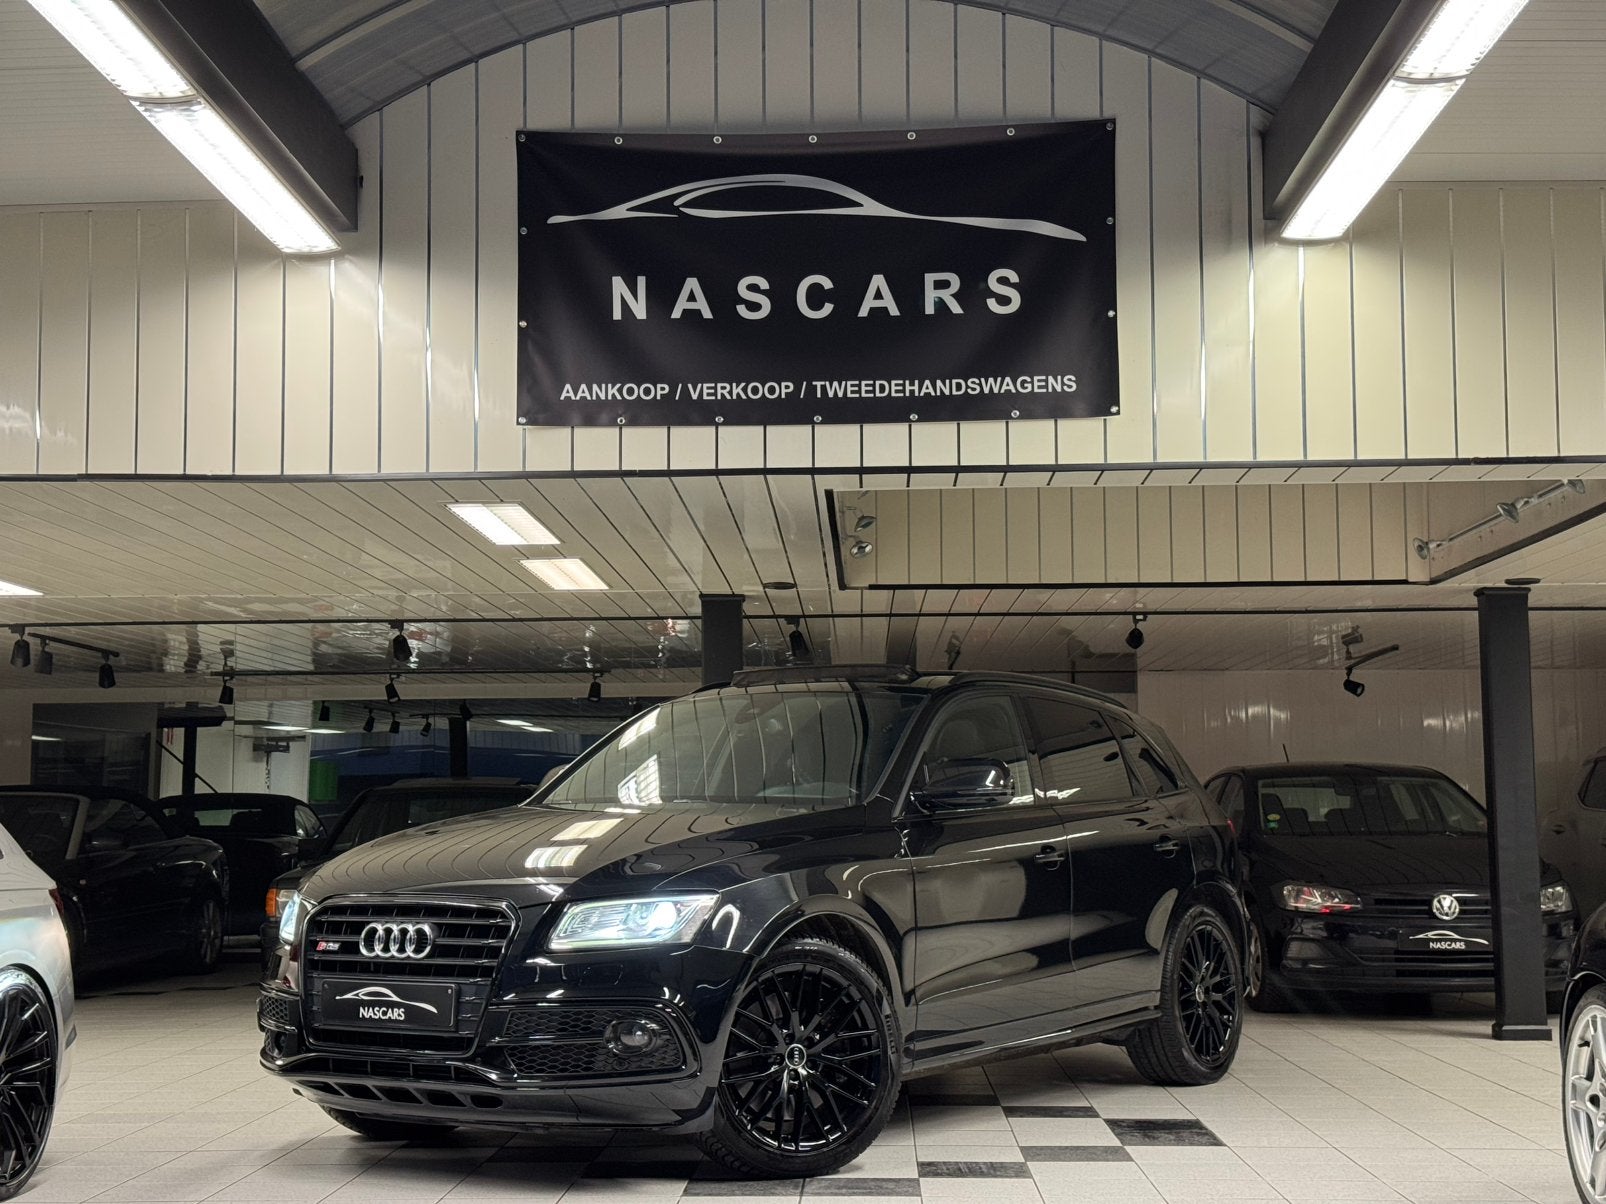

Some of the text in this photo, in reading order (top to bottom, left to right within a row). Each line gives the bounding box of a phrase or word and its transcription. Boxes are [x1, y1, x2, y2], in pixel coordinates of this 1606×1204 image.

[611, 269, 1021, 320] NASCARS
[560, 375, 1077, 400] AANKOOP / VERKOOP / TWEEDEHANDSWAGENS
[1429, 941, 1466, 949] NASCARS
[359, 1006, 405, 1020] NASCARS
